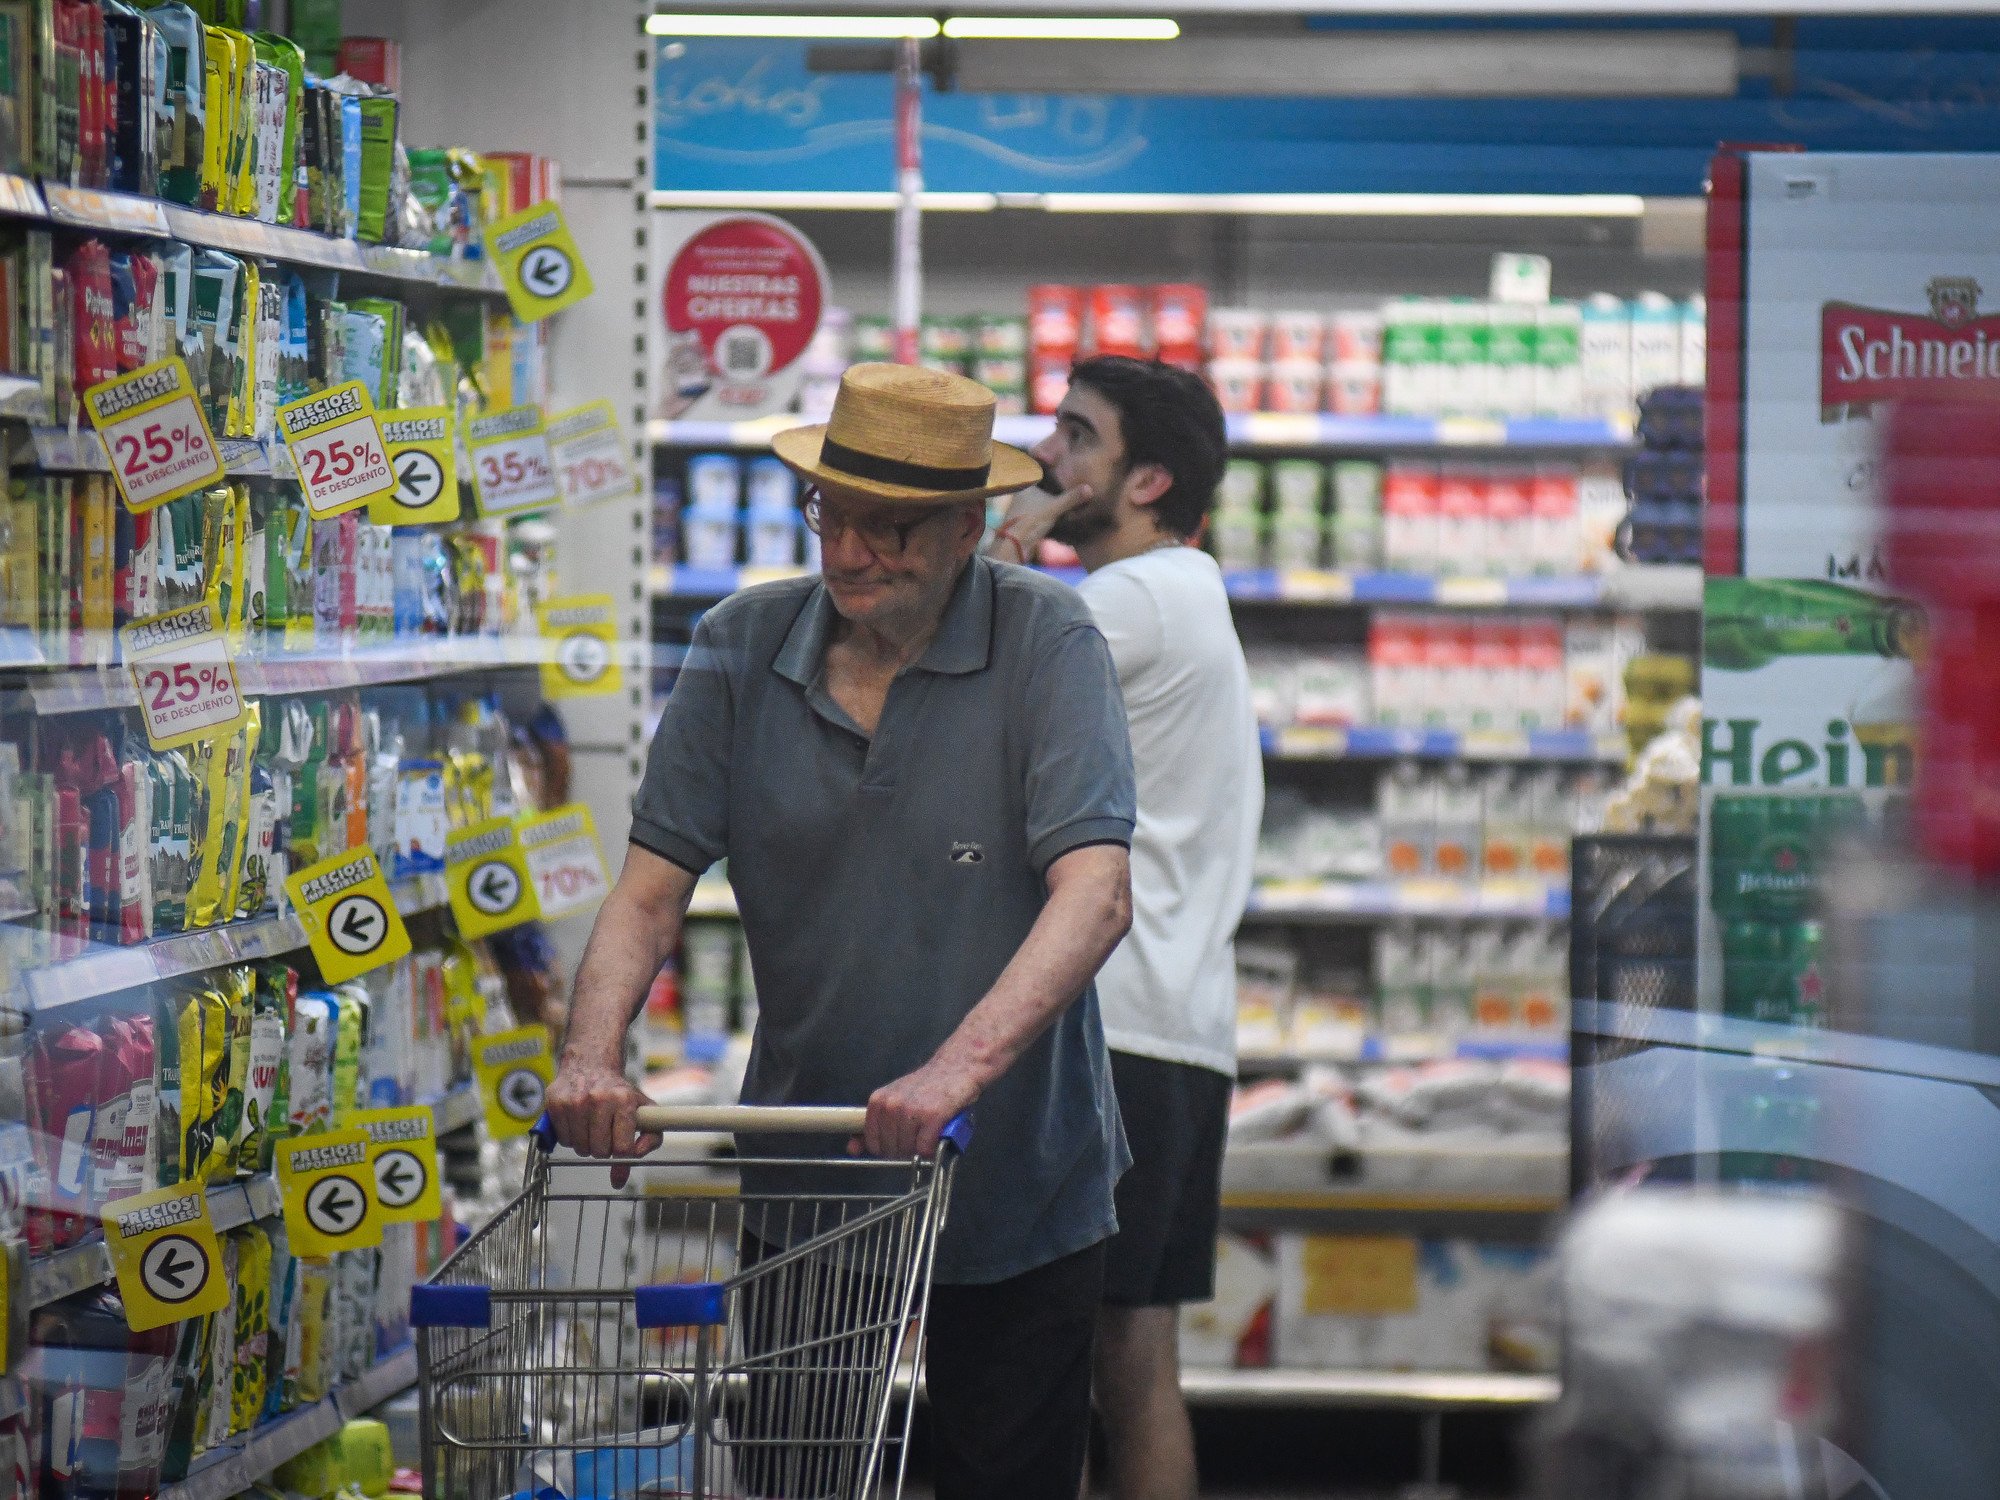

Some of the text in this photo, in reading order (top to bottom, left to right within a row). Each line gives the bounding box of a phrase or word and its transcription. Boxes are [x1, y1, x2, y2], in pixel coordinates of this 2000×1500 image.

[686, 273, 799, 294] NUESTRAS
[686, 296, 799, 320] OFERTAS
[114, 422, 204, 476] 25%
[303, 439, 381, 487] 25%
[128, 450, 210, 490] DE DESCUENTO
[313, 466, 387, 499] DE DESCUENTO
[480, 451, 548, 488] 35%
[144, 661, 229, 711] 25%
[154, 694, 233, 725] DE DESCUENTO
